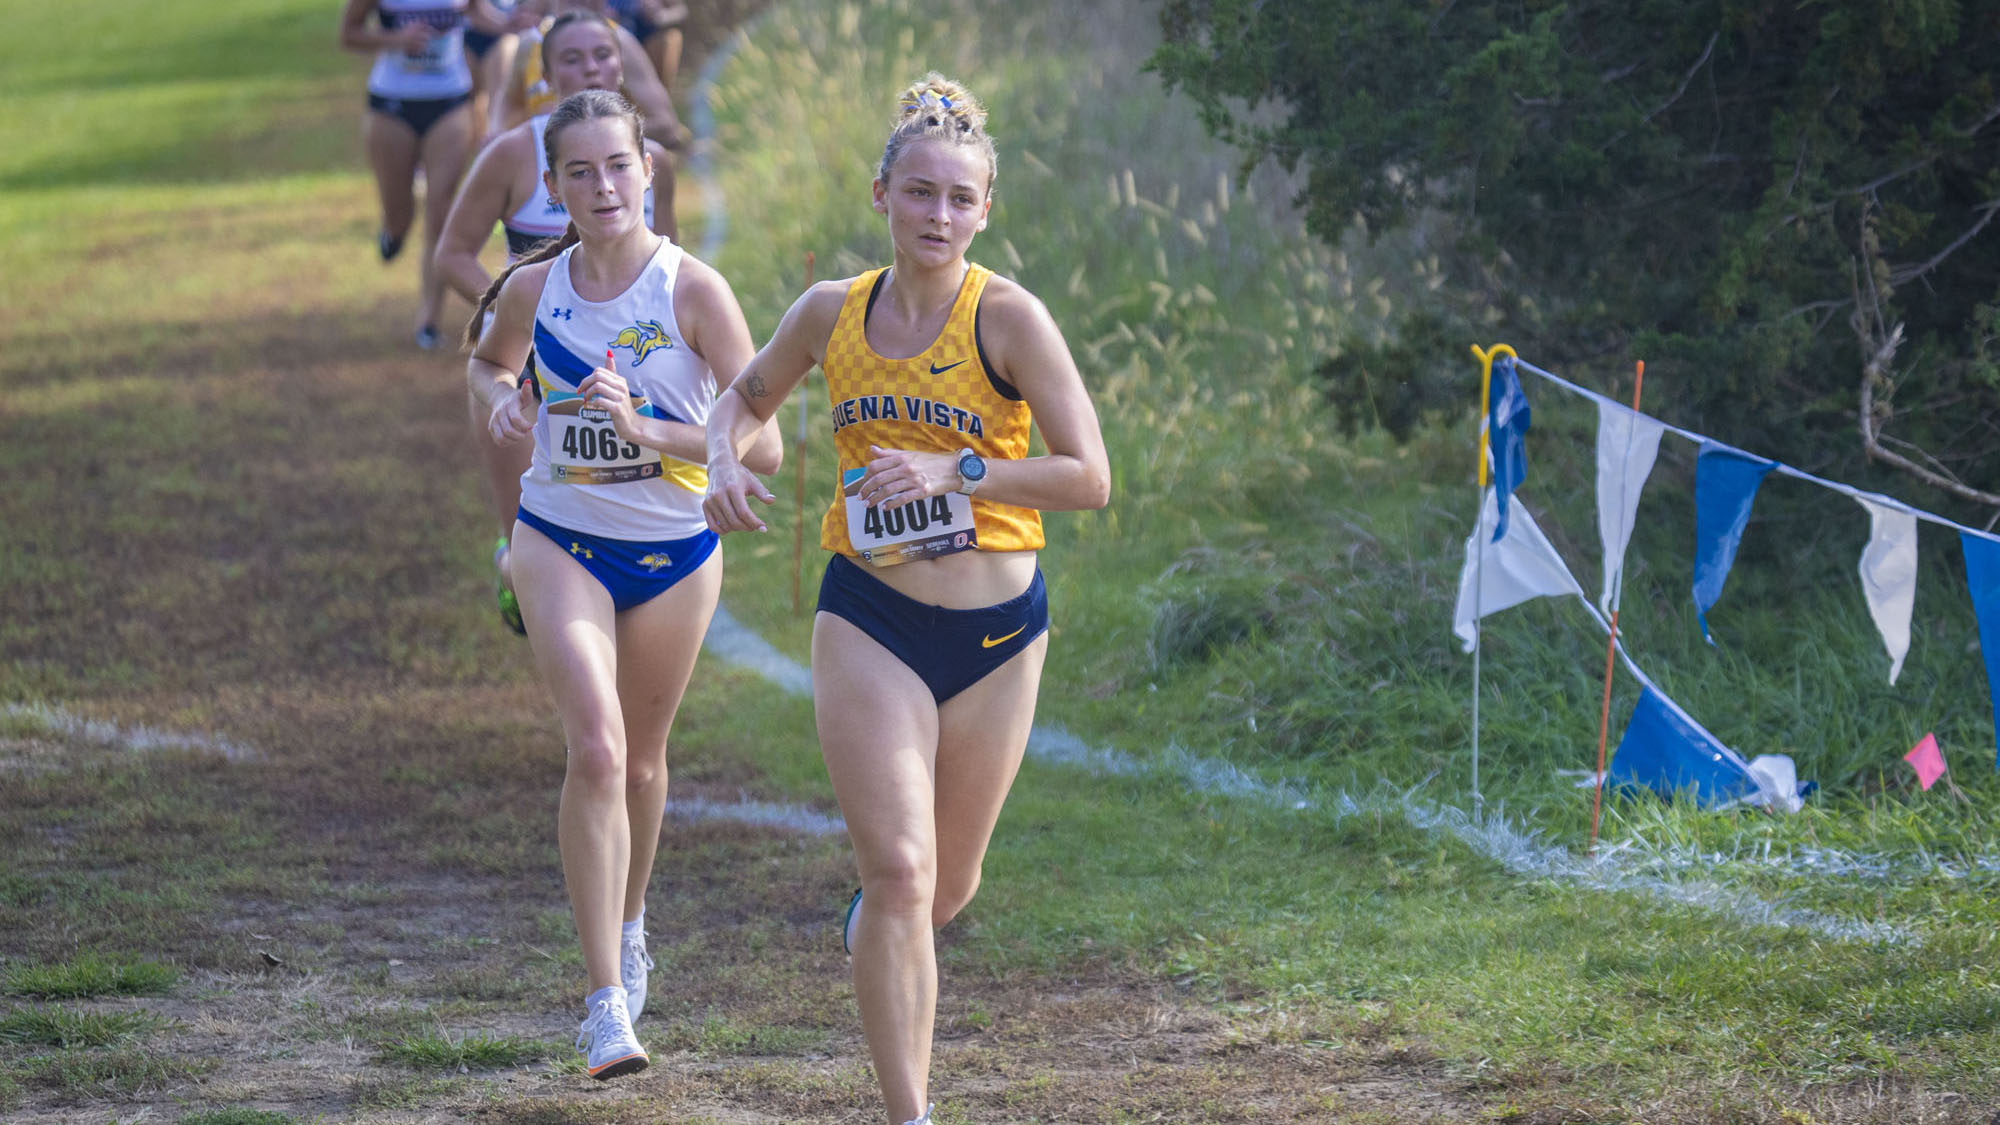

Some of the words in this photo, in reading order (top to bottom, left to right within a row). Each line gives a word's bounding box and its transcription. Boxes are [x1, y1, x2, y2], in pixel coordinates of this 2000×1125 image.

[902, 395, 984, 440] VISTA
[562, 425, 641, 462] 4063
[864, 494, 953, 539] 4004
